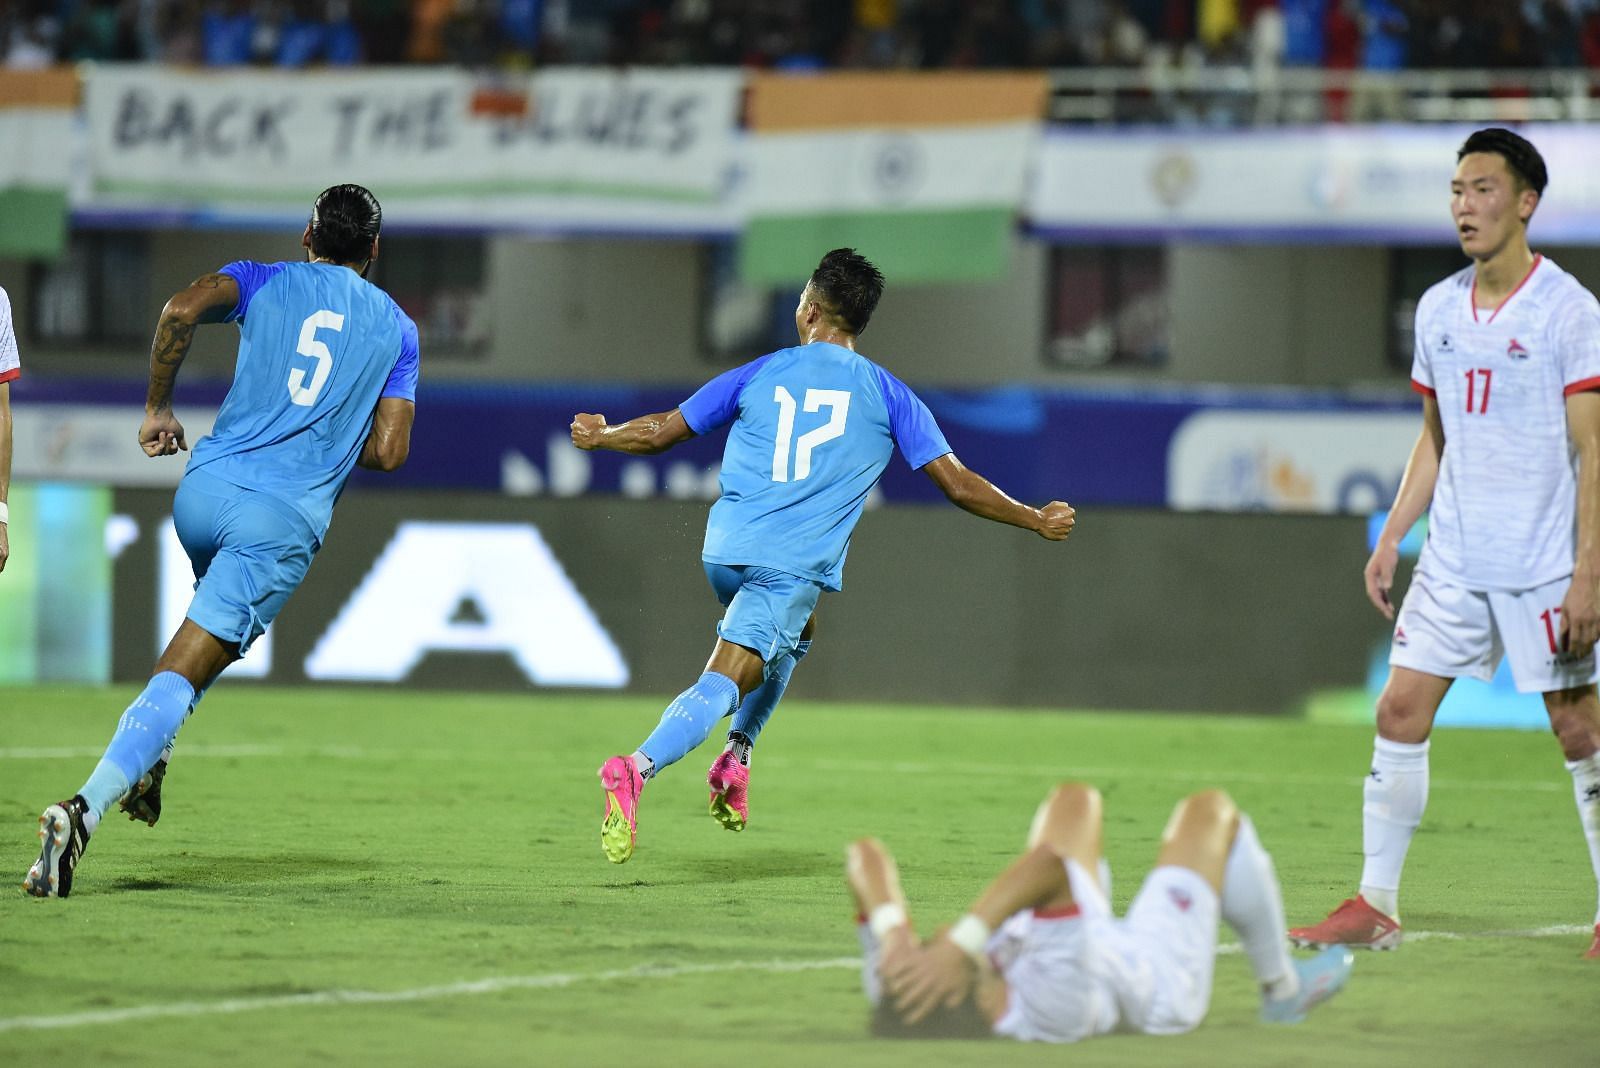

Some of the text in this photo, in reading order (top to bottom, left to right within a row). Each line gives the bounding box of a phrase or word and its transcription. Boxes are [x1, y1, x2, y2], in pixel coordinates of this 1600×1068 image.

[112, 88, 297, 162] BACK
[329, 89, 454, 160] THE
[287, 309, 344, 407] 5
[1464, 367, 1493, 415] 17
[772, 385, 851, 483] 17
